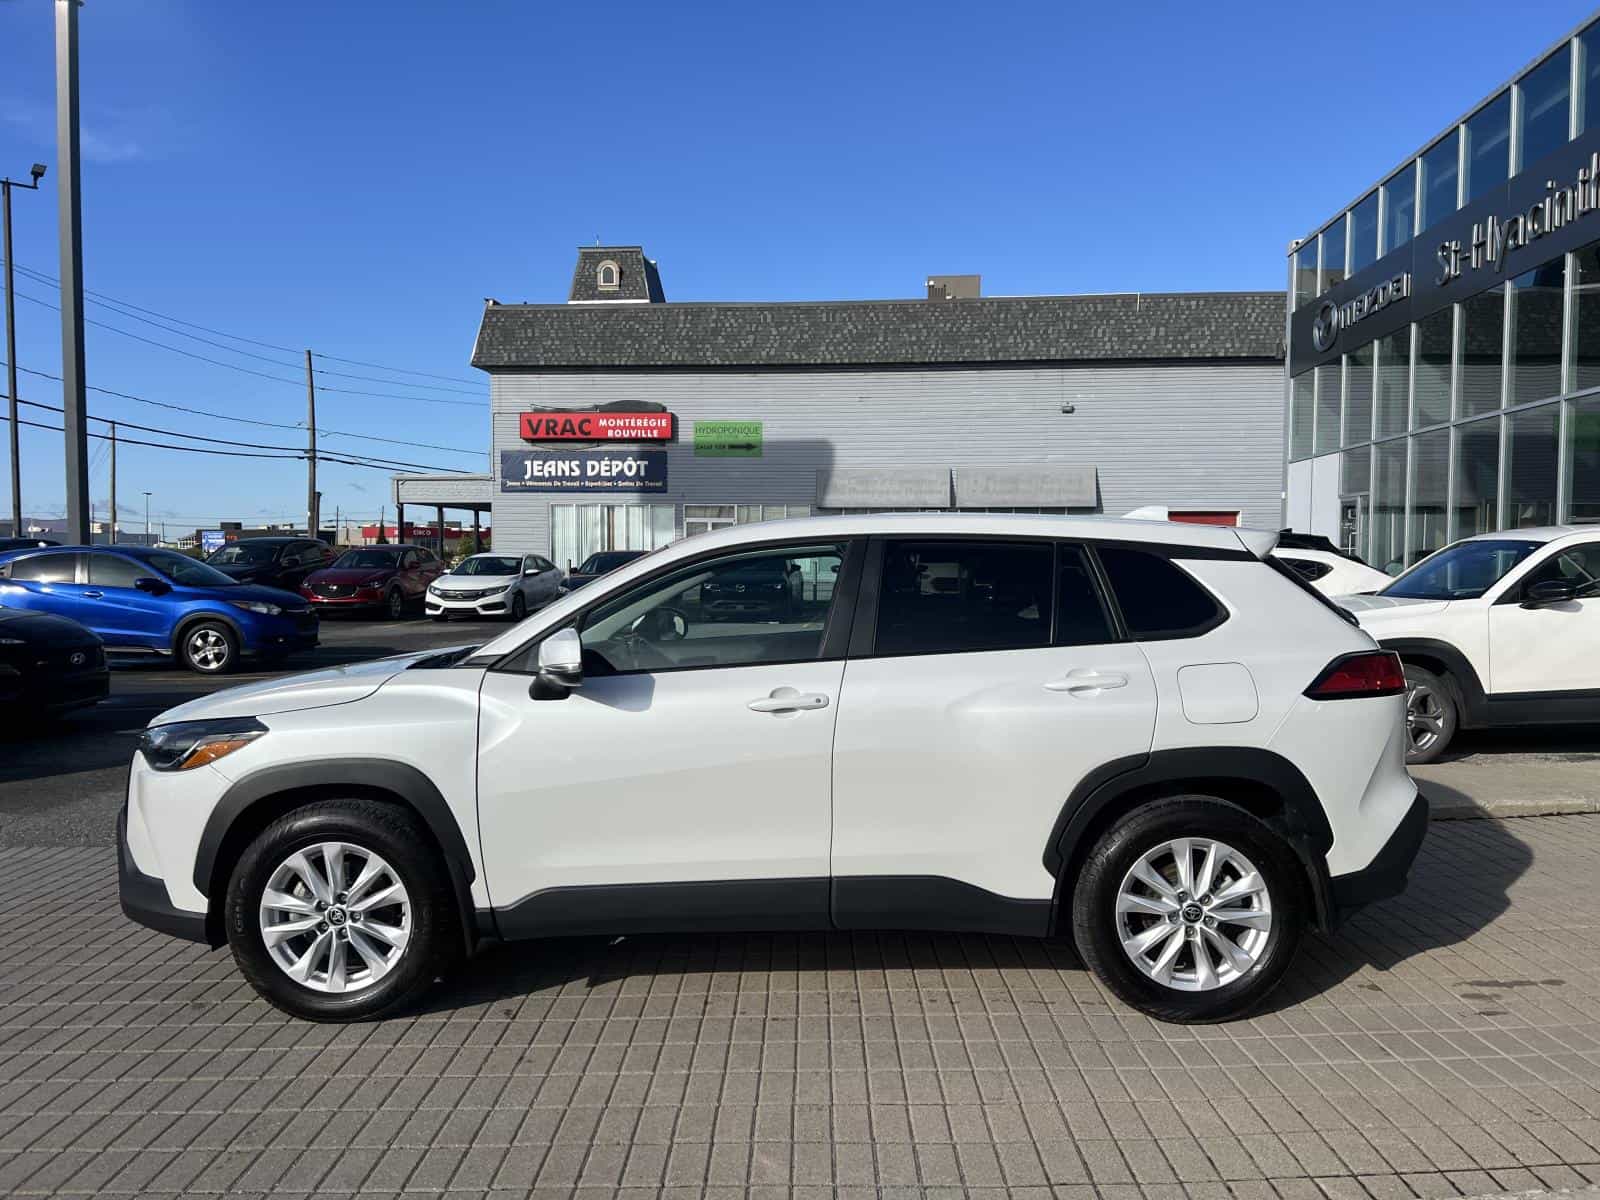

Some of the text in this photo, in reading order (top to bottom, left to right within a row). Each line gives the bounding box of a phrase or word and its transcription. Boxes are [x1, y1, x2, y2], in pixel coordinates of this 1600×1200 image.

[527, 418, 592, 436] VRAC
[599, 416, 667, 427] MONTÉRÉGIE
[607, 429, 659, 438] ROUVILLE
[524, 457, 649, 480] JEANS DÉPÔT
